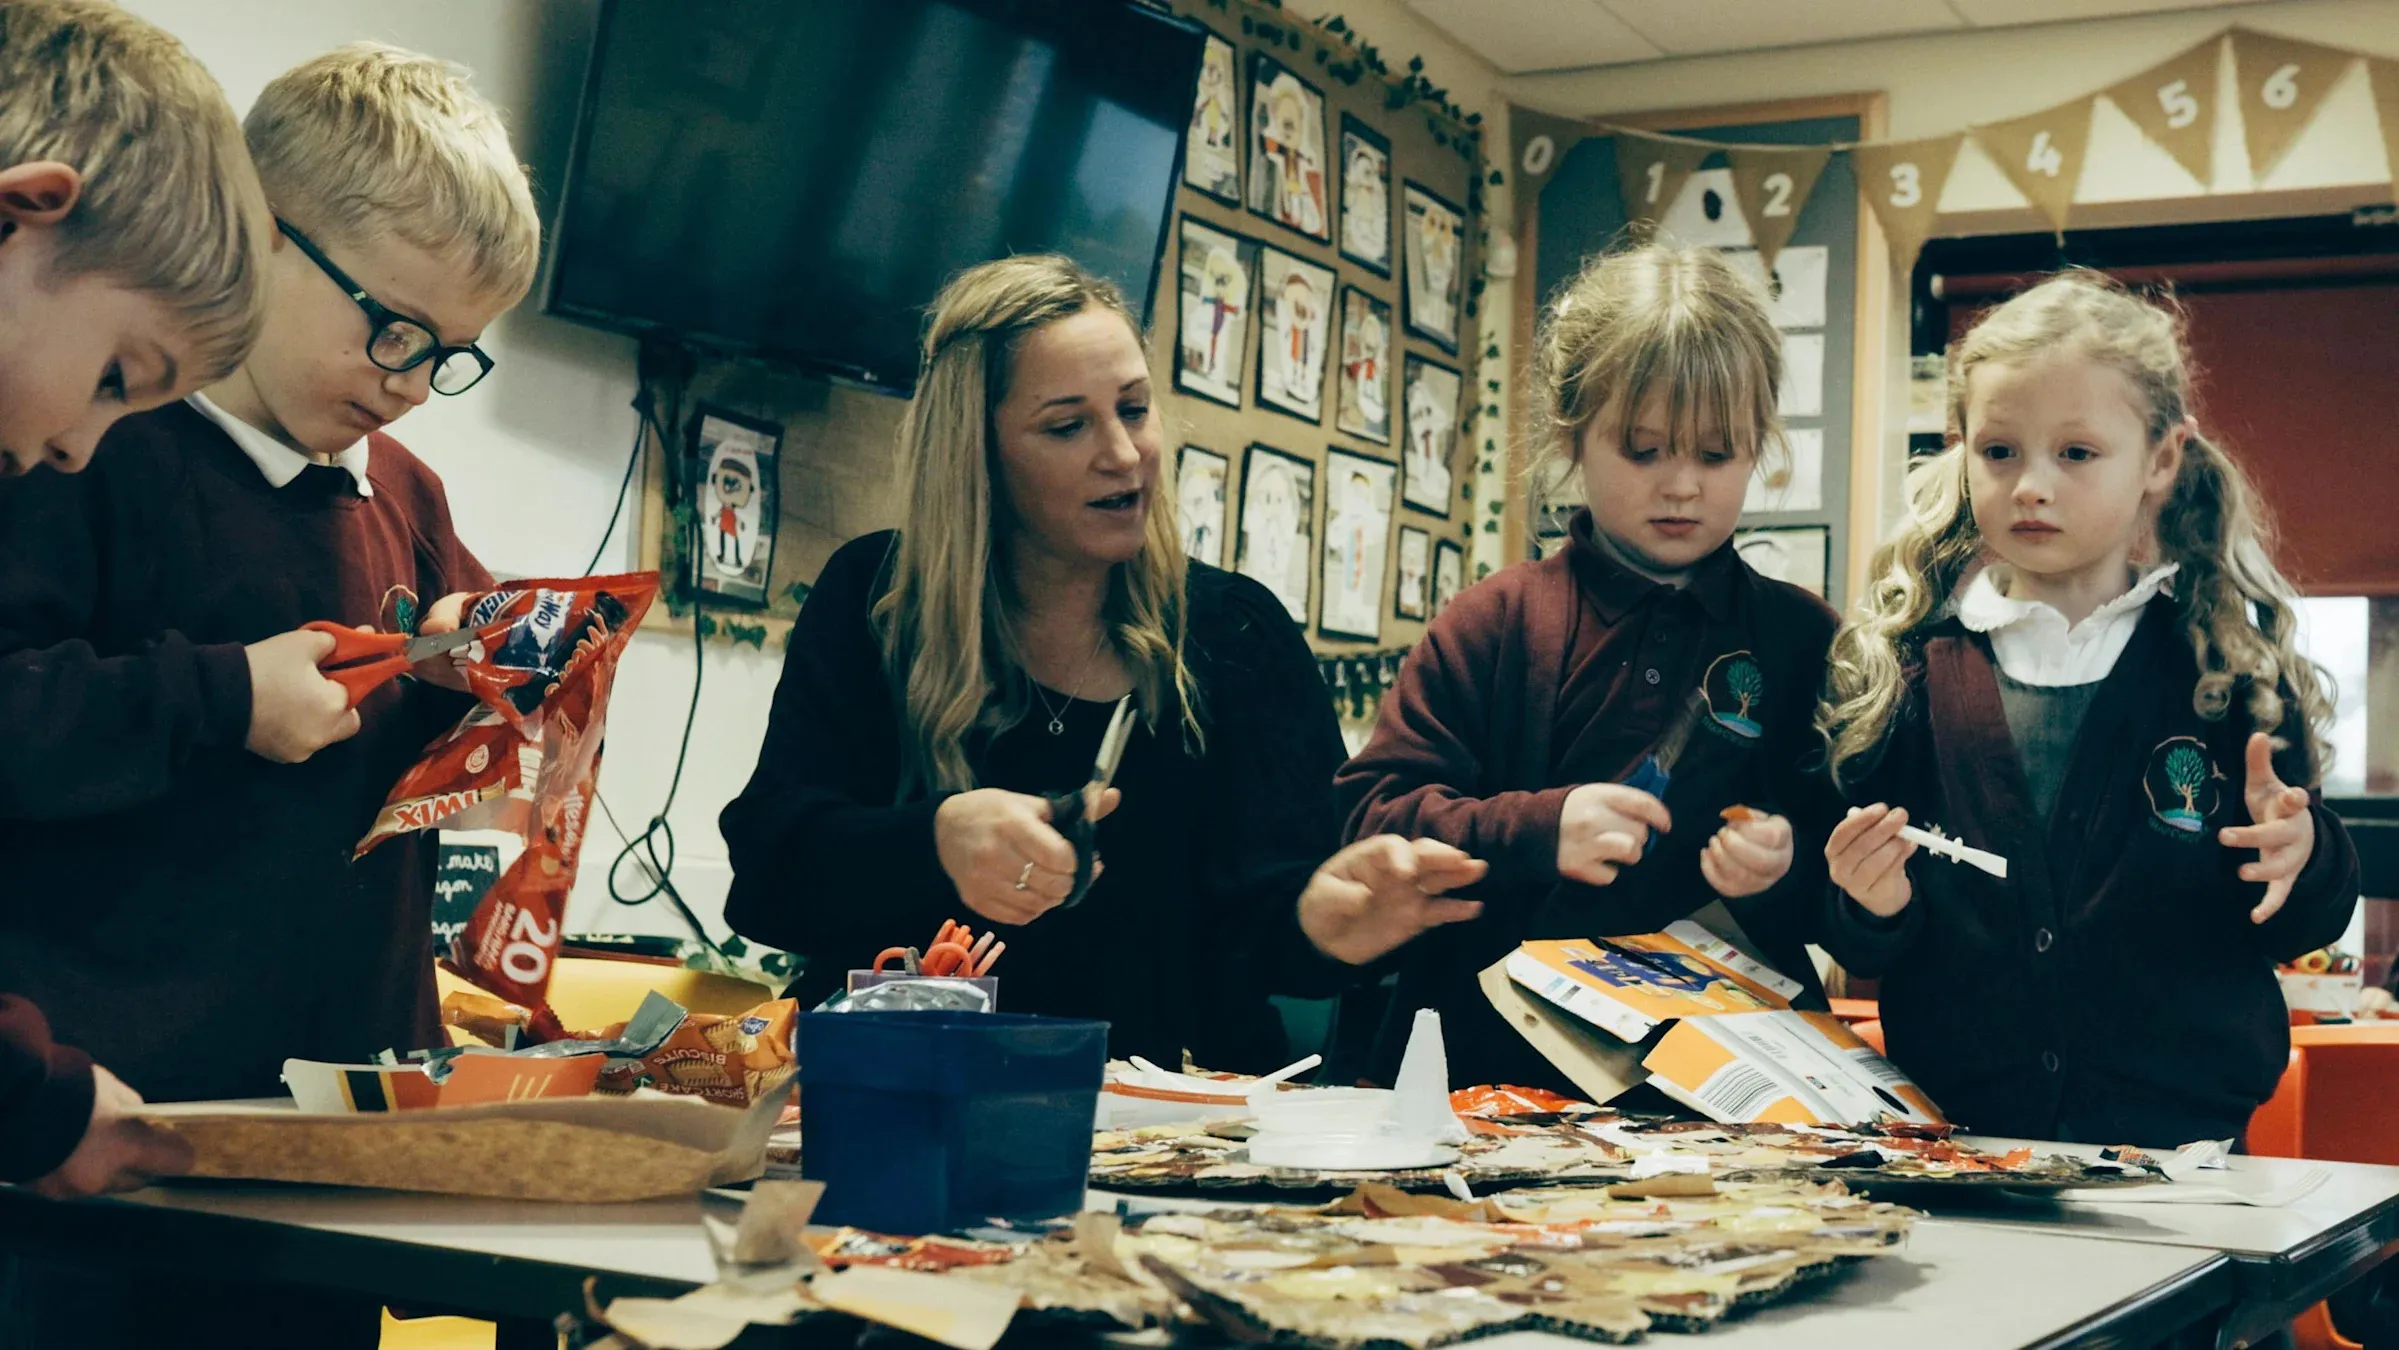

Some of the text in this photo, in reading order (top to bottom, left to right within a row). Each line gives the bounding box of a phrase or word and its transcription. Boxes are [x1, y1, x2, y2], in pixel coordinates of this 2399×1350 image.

[2157, 79, 2199, 129] 5
[2261, 63, 2299, 109] 6
[1522, 135, 1555, 175] 0
[2027, 131, 2063, 178] 4
[1645, 161, 1665, 204] 1
[1762, 173, 1794, 218] 2
[1889, 162, 1922, 208] 3
[502, 909, 557, 984] 20
[653, 1048, 727, 1066] BISCUITS
[659, 1082, 745, 1101] SHORTCAKE
